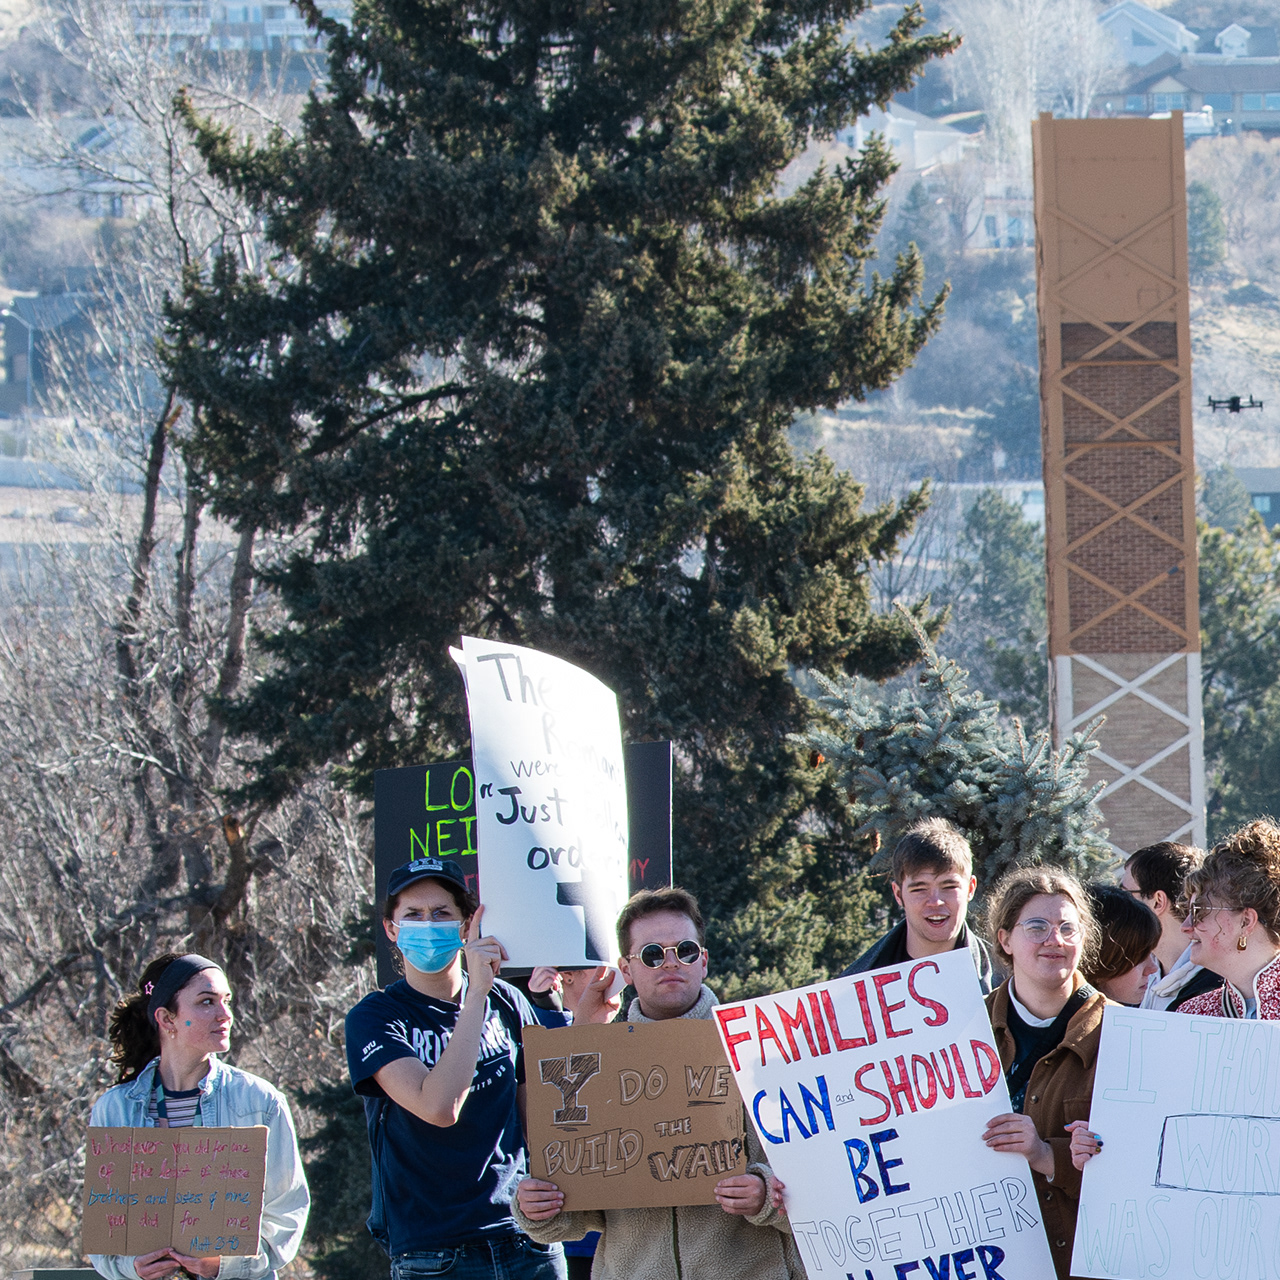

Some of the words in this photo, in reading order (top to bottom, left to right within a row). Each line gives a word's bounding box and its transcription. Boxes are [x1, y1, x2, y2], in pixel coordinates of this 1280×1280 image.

[476, 653, 551, 709] The
[510, 760, 562, 778] were
[716, 960, 949, 1072] FAMILIES
[362, 1040, 377, 1054] BYU
[1103, 1015, 1167, 1104] I
[538, 1053, 601, 1124] Y
[618, 1065, 668, 1106] DO
[685, 1065, 731, 1098] WE
[752, 1074, 836, 1144] CAN
[835, 1088, 854, 1102] and
[854, 1039, 1001, 1126] SHOULD
[91, 1134, 164, 1156] Whatever
[172, 1142, 190, 1164] you
[195, 1139, 210, 1154] did
[212, 1140, 228, 1162] for
[231, 1143, 249, 1153] one
[654, 1117, 691, 1137] THE
[99, 1162, 115, 1190] of
[132, 1161, 153, 1182] the
[159, 1158, 191, 1180] least
[201, 1165, 212, 1184] of
[219, 1164, 249, 1179] these
[543, 1128, 643, 1177] BUILD
[648, 1138, 742, 1182] WALL?
[843, 1128, 911, 1204] BE
[88, 1187, 138, 1206] brothers
[146, 1188, 168, 1205] and
[106, 1213, 127, 1238] you
[139, 1212, 159, 1228] did
[180, 1210, 200, 1234] for
[792, 1176, 1038, 1271] TOGETHER
[1080, 1194, 1171, 1278] WAS
